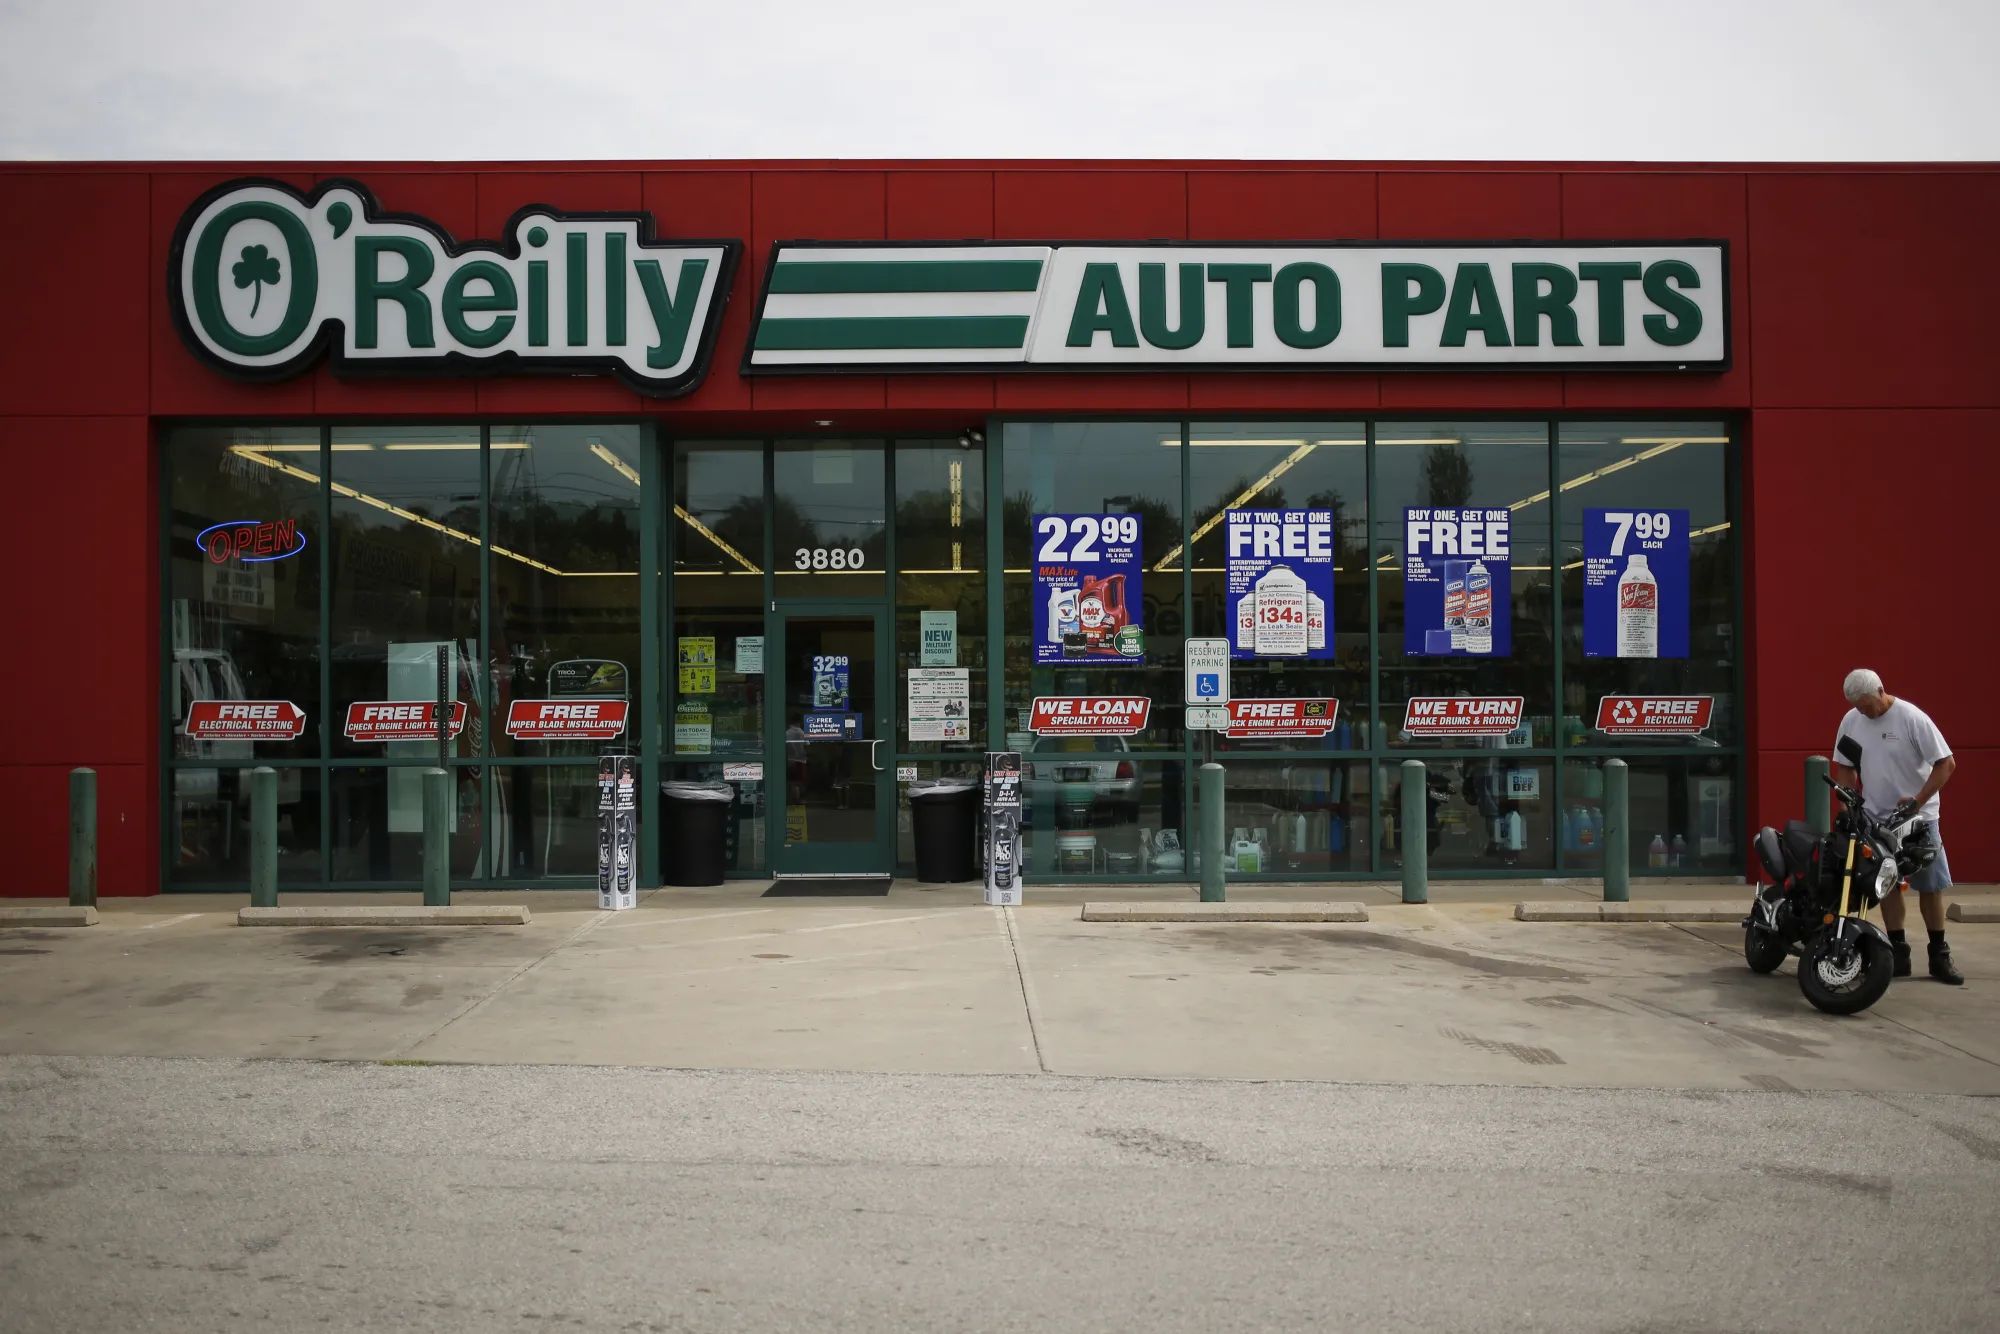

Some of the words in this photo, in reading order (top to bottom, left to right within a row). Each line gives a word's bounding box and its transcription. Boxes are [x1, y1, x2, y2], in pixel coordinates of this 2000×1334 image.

[192, 201, 709, 369] O'Reilly
[1065, 261, 1342, 350] AUTO
[1381, 259, 1703, 348] PARTS
[1229, 512, 1252, 522] BUY
[1254, 512, 1282, 525] TWO,
[1285, 512, 1306, 522] GET
[1308, 512, 1330, 522] ONE
[1408, 510, 1430, 520] BUY
[1434, 510, 1459, 522] ONE,
[1462, 510, 1482, 520] GET
[1486, 510, 1508, 520] ONE
[208, 519, 295, 563] OPEN
[1230, 524, 1332, 556] FREE
[1408, 522, 1509, 554] FREE
[795, 548, 865, 570] 3880
[1039, 566, 1064, 576] MAX
[1065, 568, 1078, 576] Life
[1470, 580, 1486, 588] GUNK
[1470, 593, 1488, 601] Glass
[1083, 608, 1100, 616] MAX
[1260, 607, 1302, 623] 134a
[924, 630, 952, 642] NEW
[1189, 648, 1226, 656] RESERVED
[219, 705, 280, 718] FREE
[364, 706, 424, 720] FREE
[540, 705, 600, 718] FREE
[1038, 700, 1074, 714] WE
[1080, 700, 1144, 714] LOAN
[1236, 704, 1296, 717] FREE
[1414, 701, 1448, 714] WE
[1455, 701, 1516, 714] TURN
[1642, 700, 1700, 714] FREE
[199, 720, 252, 730] ELECTRICAL
[256, 720, 293, 730] TESTING
[348, 722, 373, 730] CHECK
[375, 722, 402, 730] ENGINE
[405, 722, 428, 730] LIGHT
[430, 721, 460, 729] TENG
[510, 720, 536, 728] WIPER
[538, 720, 564, 728] BLADE
[567, 720, 622, 728] INSTALLATION
[1050, 716, 1099, 725] SPECIALTY
[1102, 716, 1130, 725] TOOLS
[1248, 719, 1274, 727] ENGINE
[1277, 718, 1298, 726] LIGHT
[1408, 716, 1437, 725] BRAKE
[1440, 716, 1471, 725] DRUMS
[1473, 716, 1480, 725] &
[1483, 716, 1516, 725] ROTORS
[1644, 716, 1694, 724] RECYCLING
[1512, 776, 1533, 784] Blue
[1512, 784, 1533, 792] DEF
[618, 855, 628, 864] PRO
[996, 852, 1010, 861] PRO
